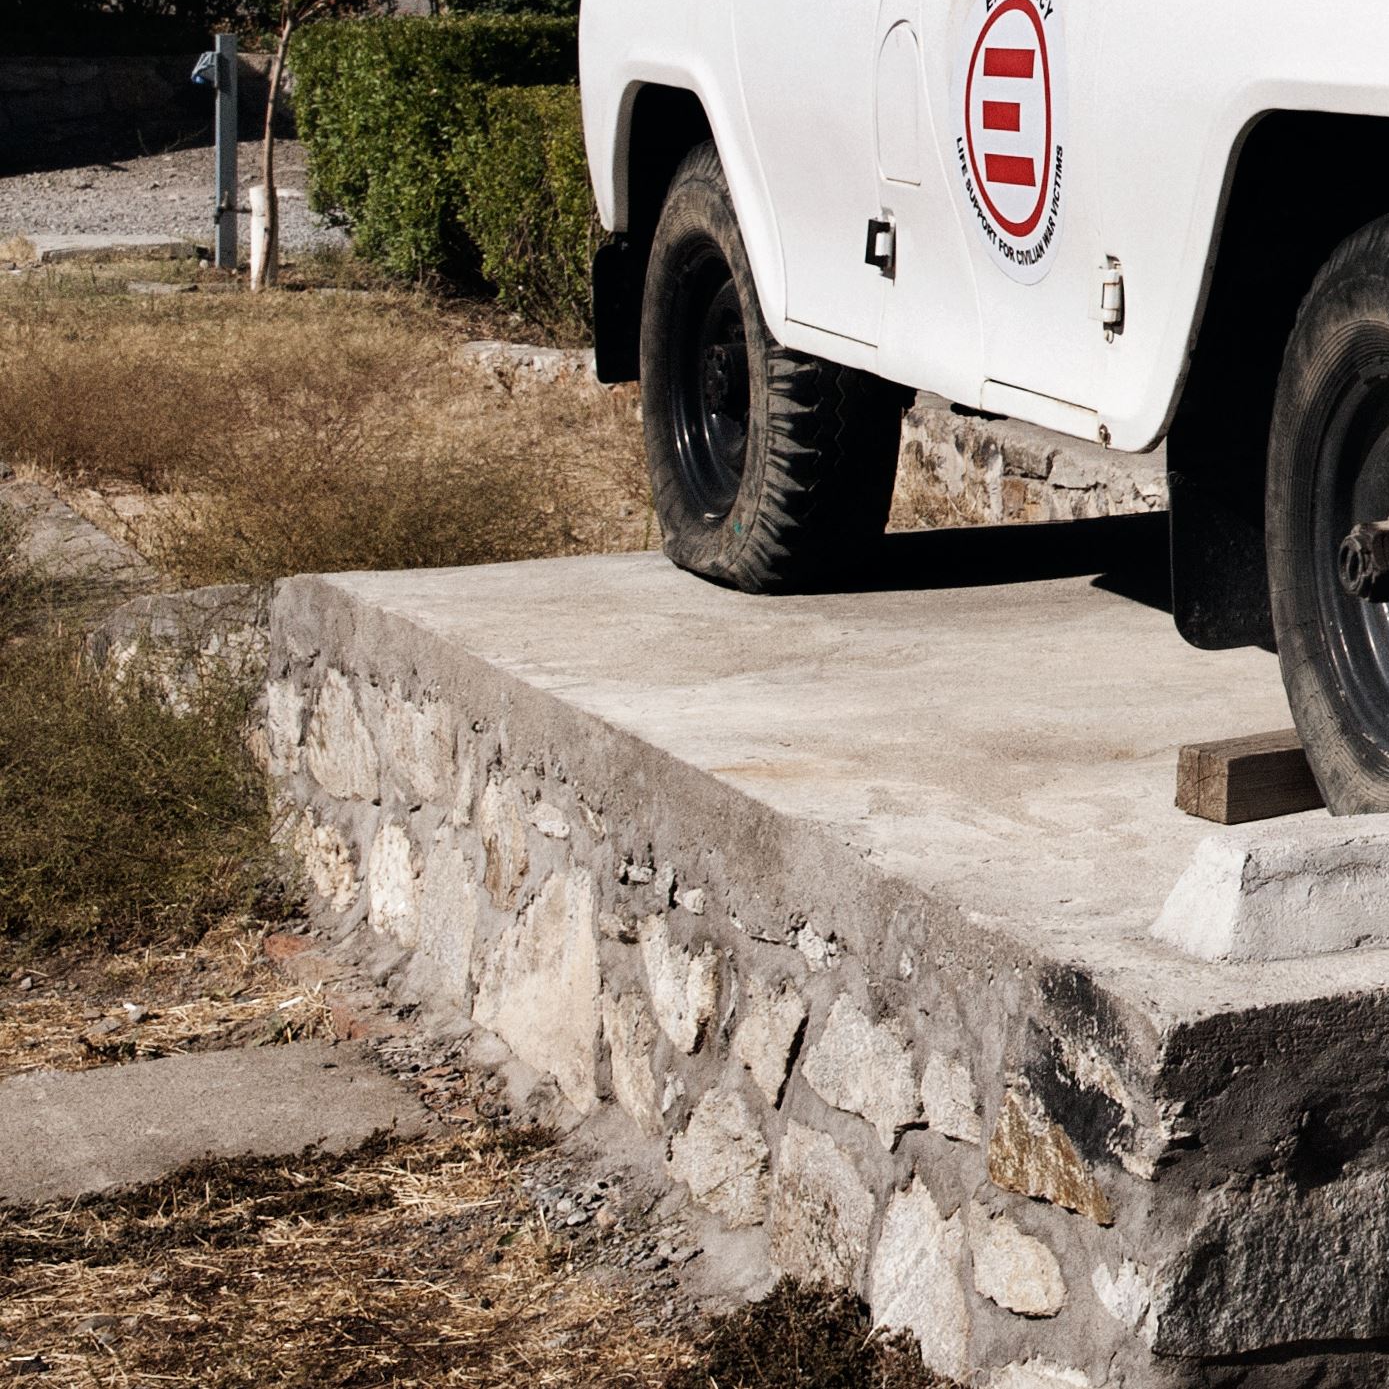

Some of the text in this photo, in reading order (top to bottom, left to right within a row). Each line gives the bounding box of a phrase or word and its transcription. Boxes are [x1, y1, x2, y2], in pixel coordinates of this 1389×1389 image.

[956, 136, 1064, 267] LIFE SUPPORT FOR CIVILIAN WAR VICTIMS
